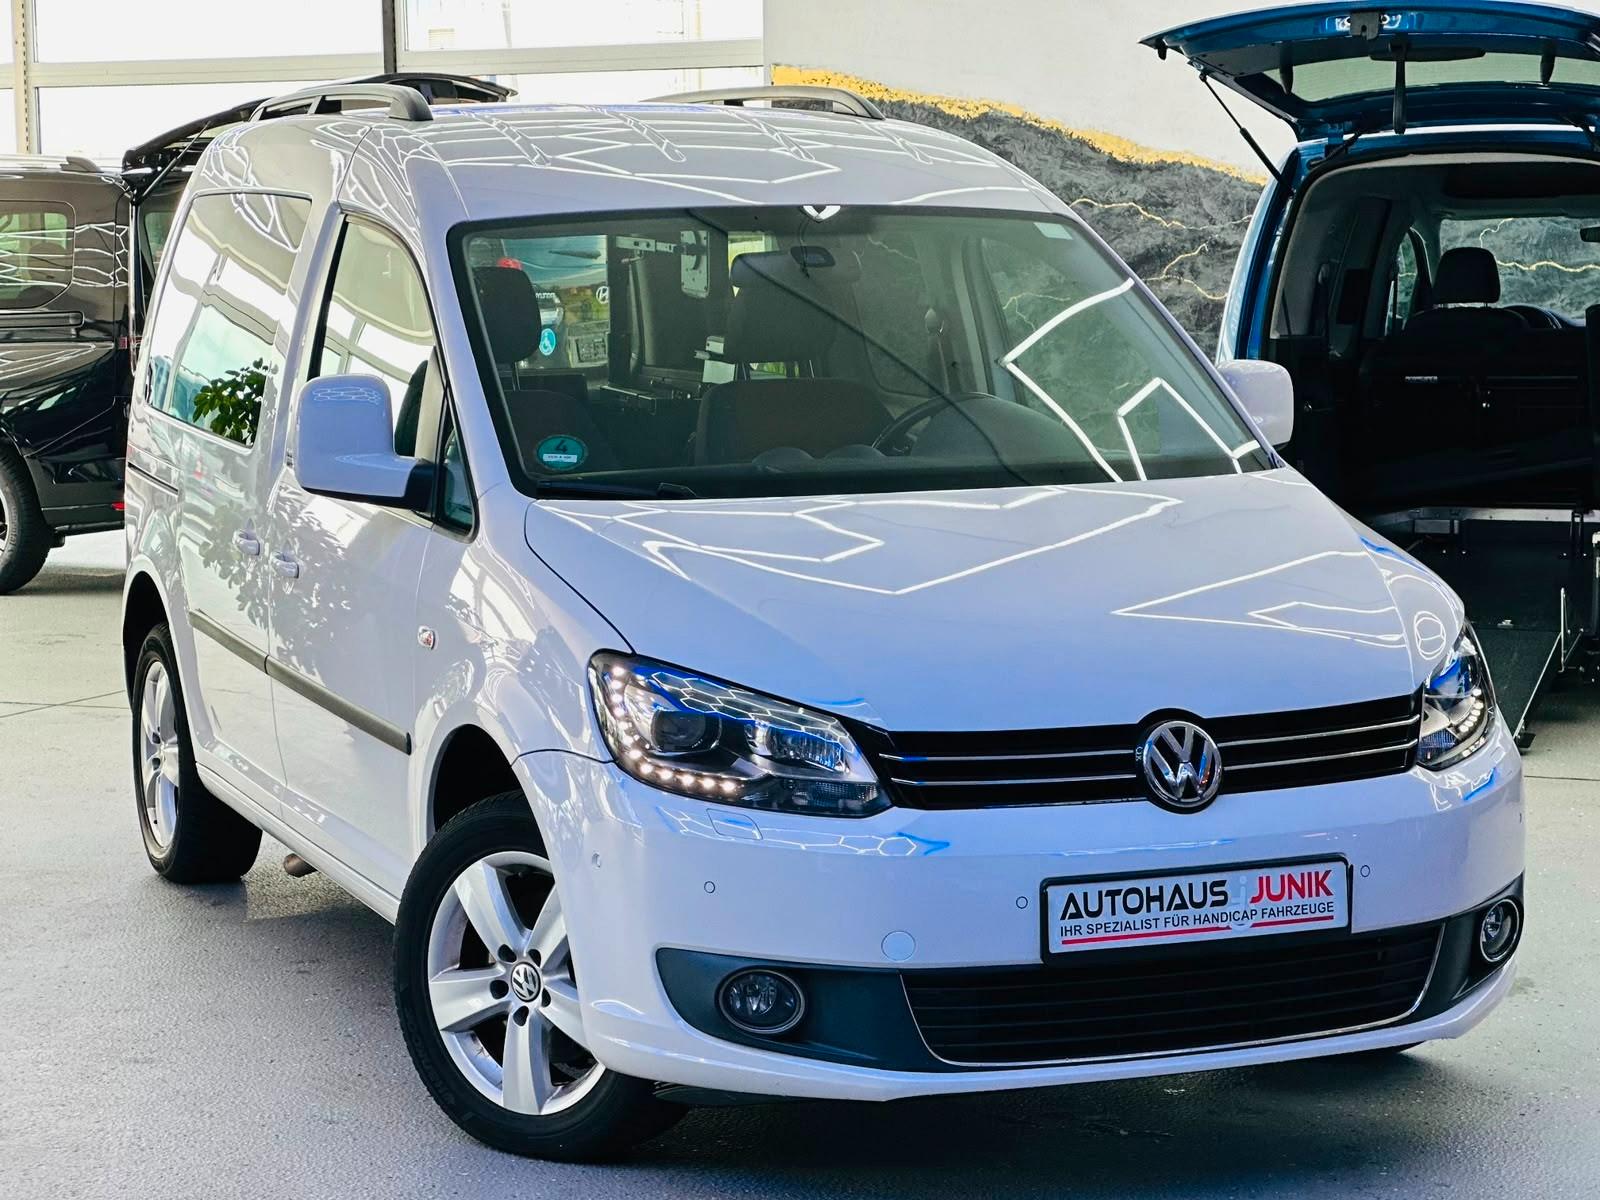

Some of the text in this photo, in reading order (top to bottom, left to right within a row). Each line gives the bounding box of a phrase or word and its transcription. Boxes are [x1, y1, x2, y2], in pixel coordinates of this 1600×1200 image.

[555, 440, 568, 453] 4
[1060, 869, 1334, 920] AUTOHAUS JUNIK
[1060, 901, 1334, 937] IHR SPEZIALIST FÜR HANDICAP FAHRZEUGE
